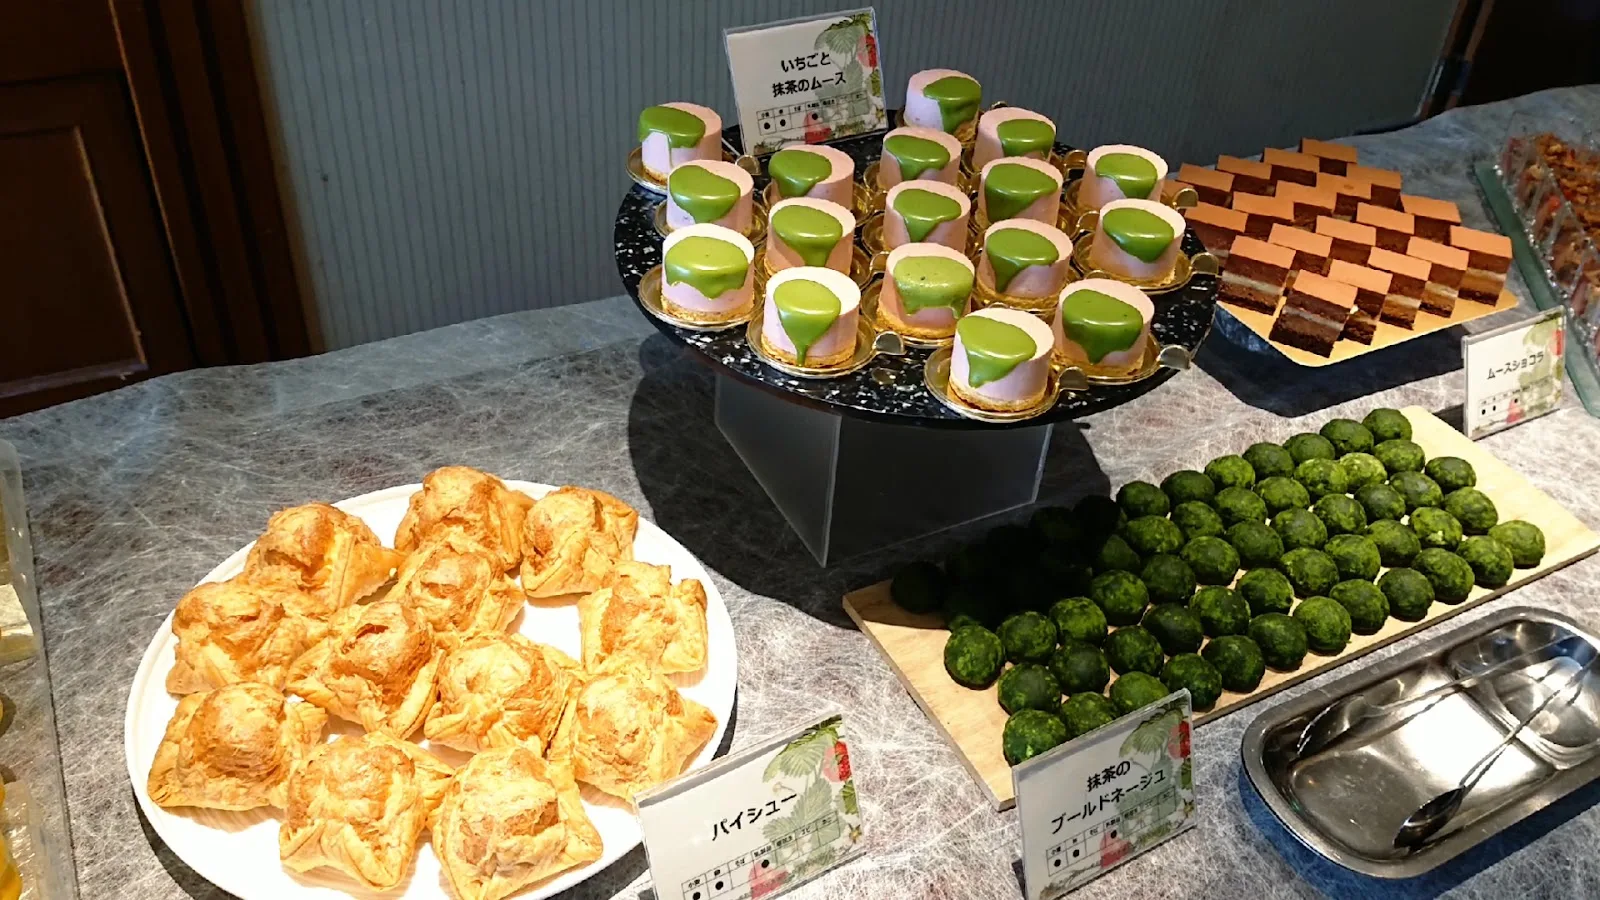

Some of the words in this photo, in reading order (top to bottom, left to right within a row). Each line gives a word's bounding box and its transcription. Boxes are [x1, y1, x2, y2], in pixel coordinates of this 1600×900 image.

[780, 52, 831, 72] いちごと
[772, 71, 846, 97] 抹茶のムース
[1487, 351, 1544, 380] ムースショコラ
[1086, 760, 1131, 793] 抹茶の
[712, 793, 797, 841] パイシュー
[1051, 769, 1166, 835] ブールドネージュ
